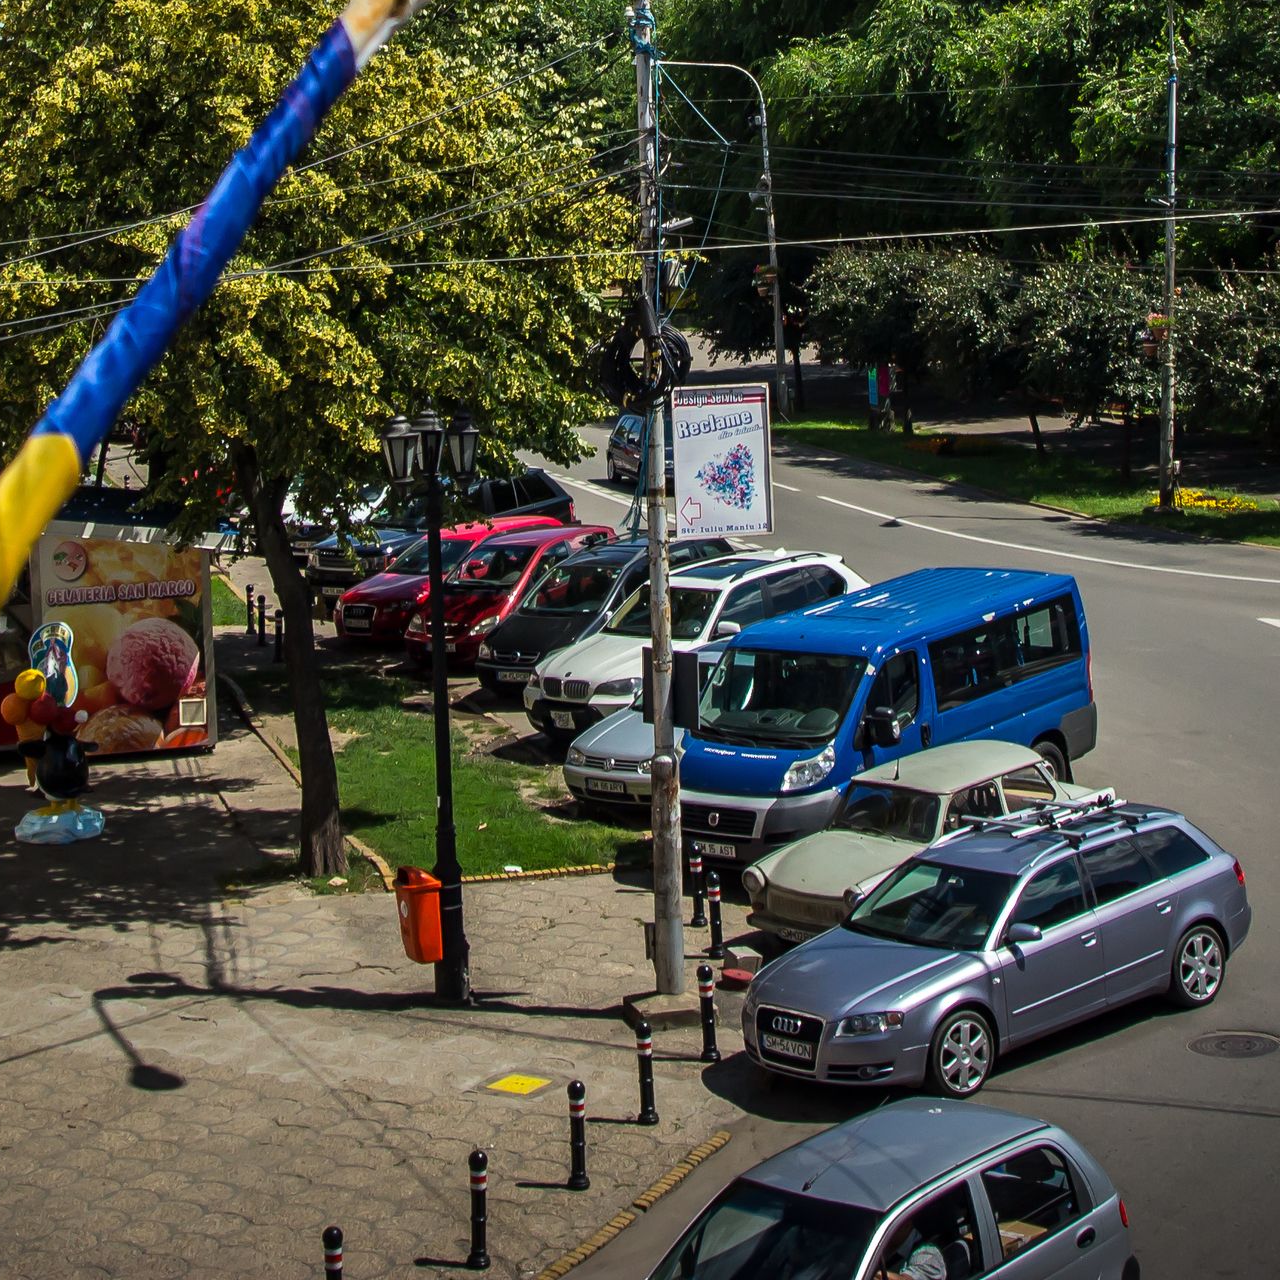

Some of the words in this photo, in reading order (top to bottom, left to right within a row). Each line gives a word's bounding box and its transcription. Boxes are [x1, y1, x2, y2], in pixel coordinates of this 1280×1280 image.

[676, 410, 753, 439] Reclame
[700, 525, 723, 533] Iuliu
[726, 523, 755, 532] Maniu
[47, 585, 116, 606] GELATERIA
[118, 582, 145, 600] SAN
[148, 579, 195, 598] MARCO
